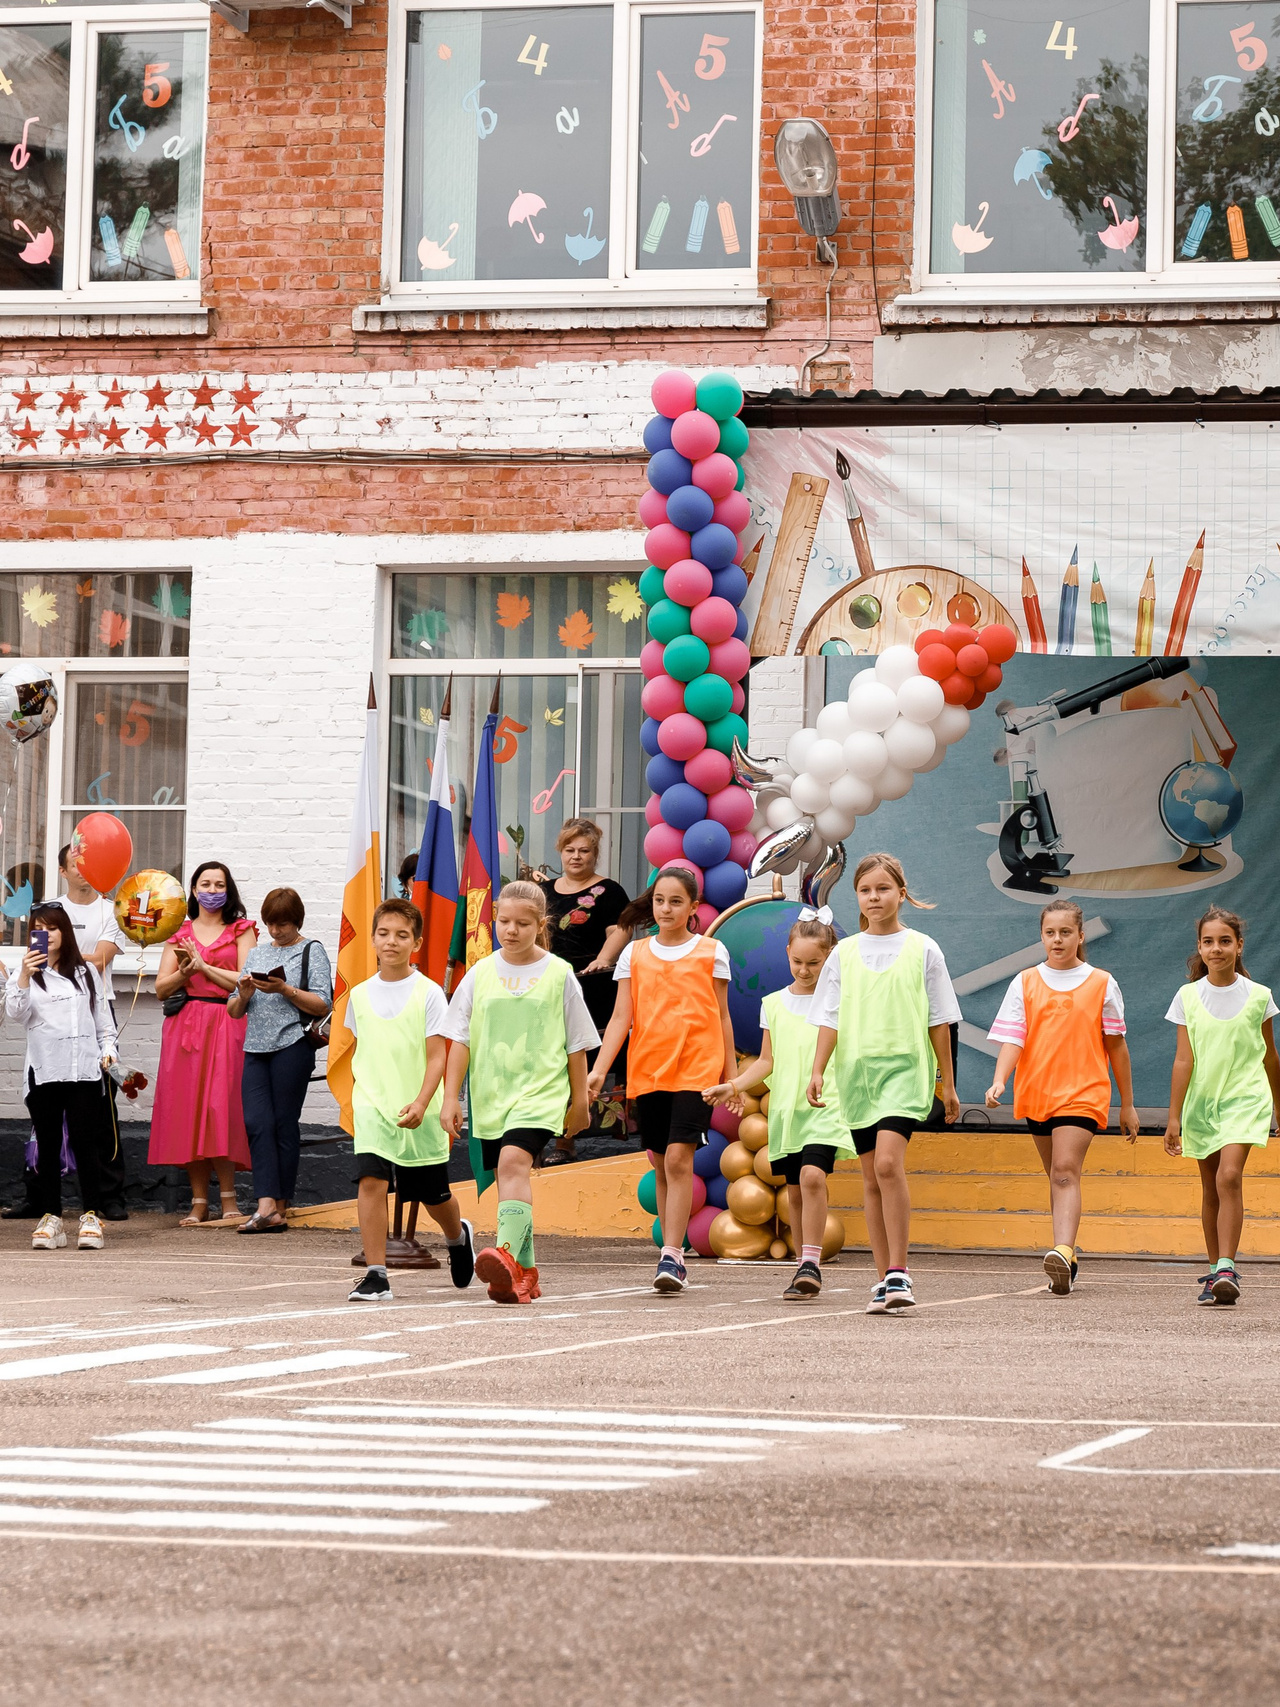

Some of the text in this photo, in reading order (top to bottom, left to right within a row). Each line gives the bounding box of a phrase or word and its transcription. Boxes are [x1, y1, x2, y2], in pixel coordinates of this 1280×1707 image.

[517, 34, 550, 75] 4
[694, 33, 730, 80] 5
[1045, 20, 1078, 60] 4
[1229, 21, 1268, 71] 5
[142, 62, 172, 108] 5
[119, 699, 157, 747] 5
[493, 715, 528, 764] 5
[136, 890, 150, 915] 1
